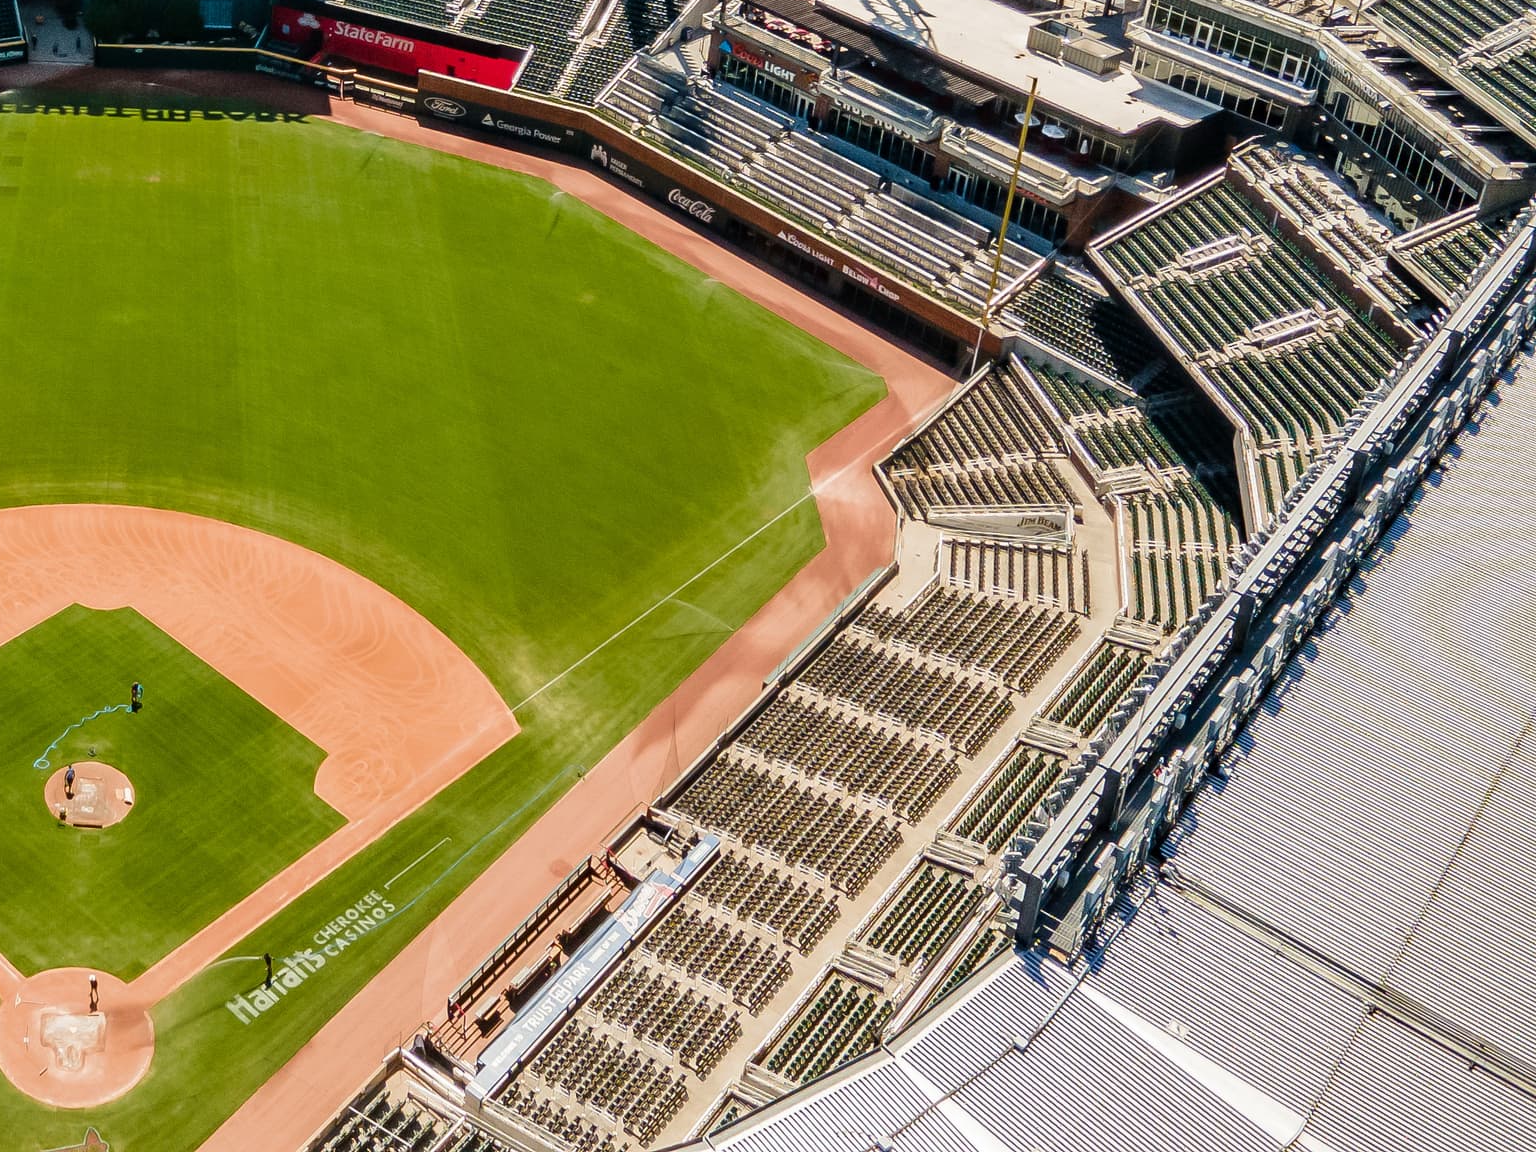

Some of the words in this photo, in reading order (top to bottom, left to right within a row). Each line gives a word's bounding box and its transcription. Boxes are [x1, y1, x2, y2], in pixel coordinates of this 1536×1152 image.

[765, 63, 796, 83] LIGHT
[431, 99, 457, 114] Ford
[496, 120, 532, 136] Georgia
[533, 129, 562, 144] Power
[668, 188, 716, 224] Coca-Cola
[811, 249, 835, 267] LIGHT
[842, 264, 870, 286] BELOW
[1016, 517, 1036, 527] JIM
[1037, 516, 1062, 531] BEAM
[313, 890, 383, 945] CHEROKEE
[324, 900, 396, 957] CASINOS
[521, 998, 558, 1032] TRUIST
[564, 962, 592, 993] PARK
